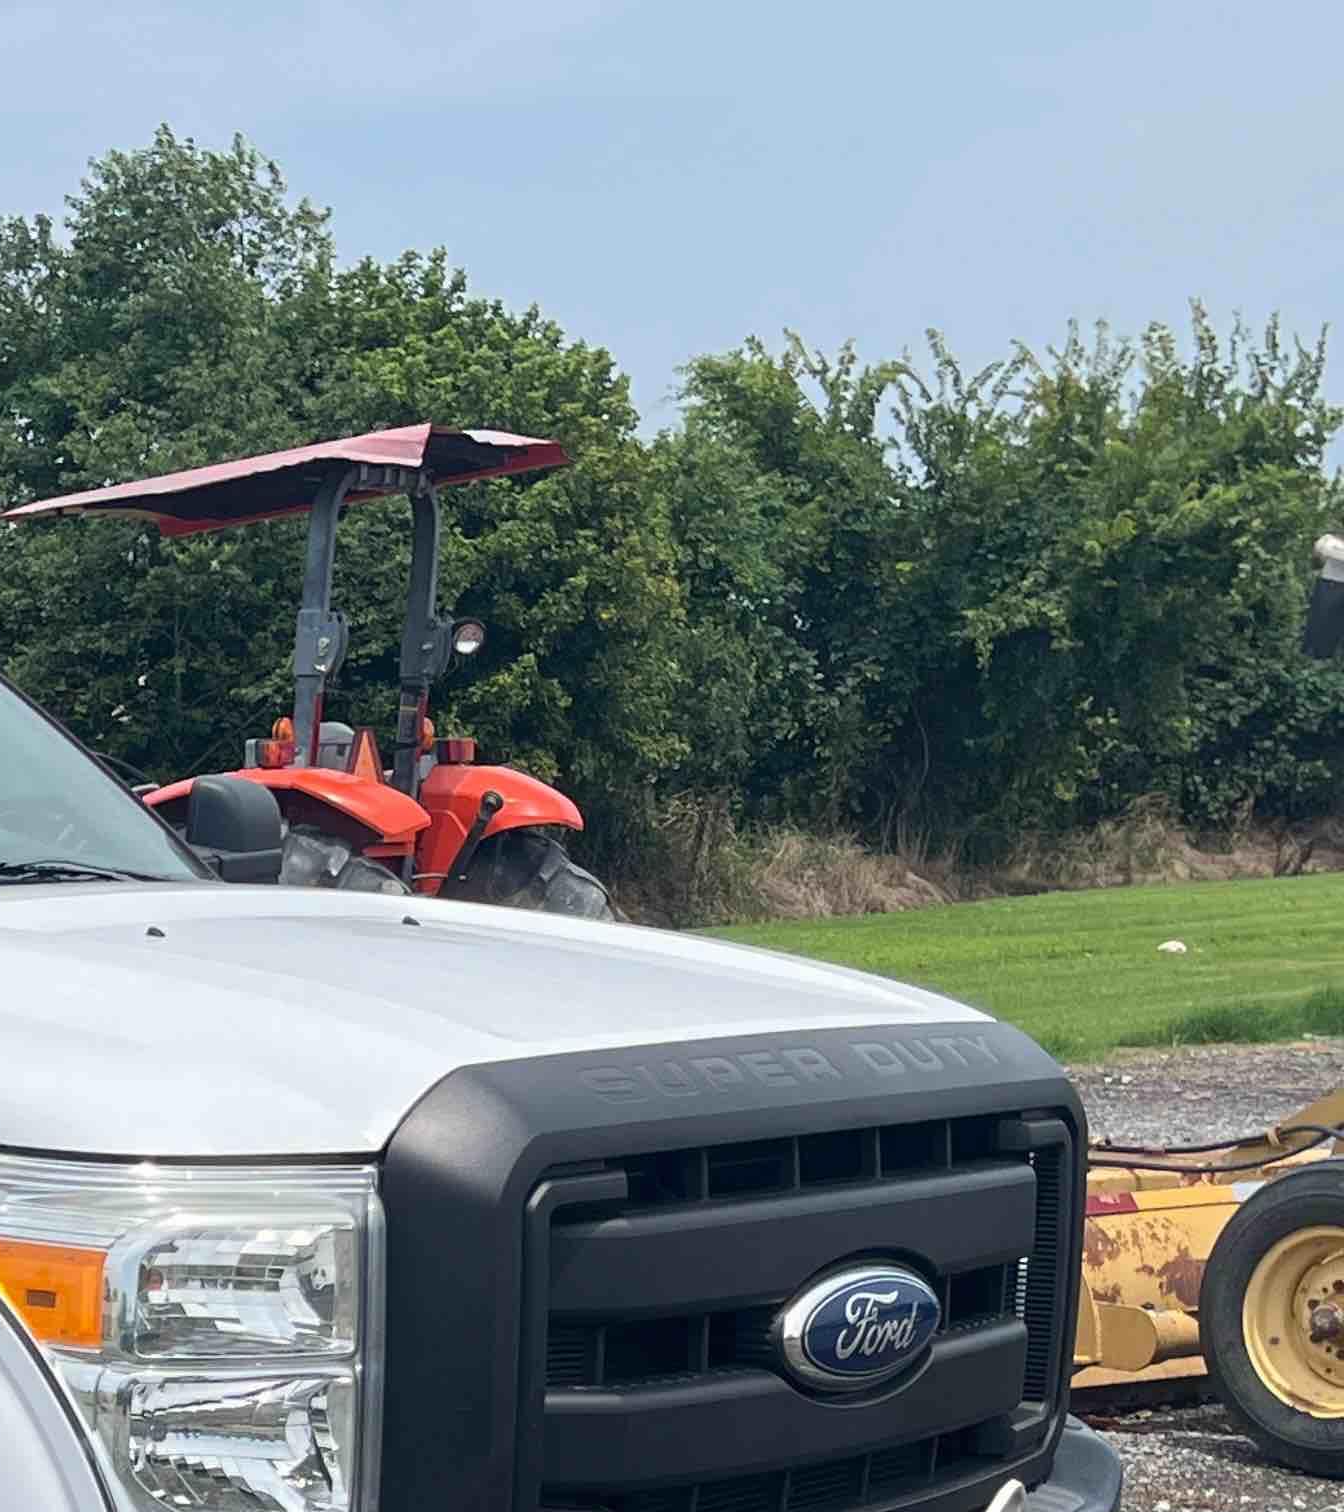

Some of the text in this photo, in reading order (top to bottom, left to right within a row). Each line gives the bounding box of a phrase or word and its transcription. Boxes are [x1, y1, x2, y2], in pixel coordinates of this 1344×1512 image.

[579, 1032, 1002, 1104] SUPER DUTY
[835, 1289, 919, 1360] Ford
